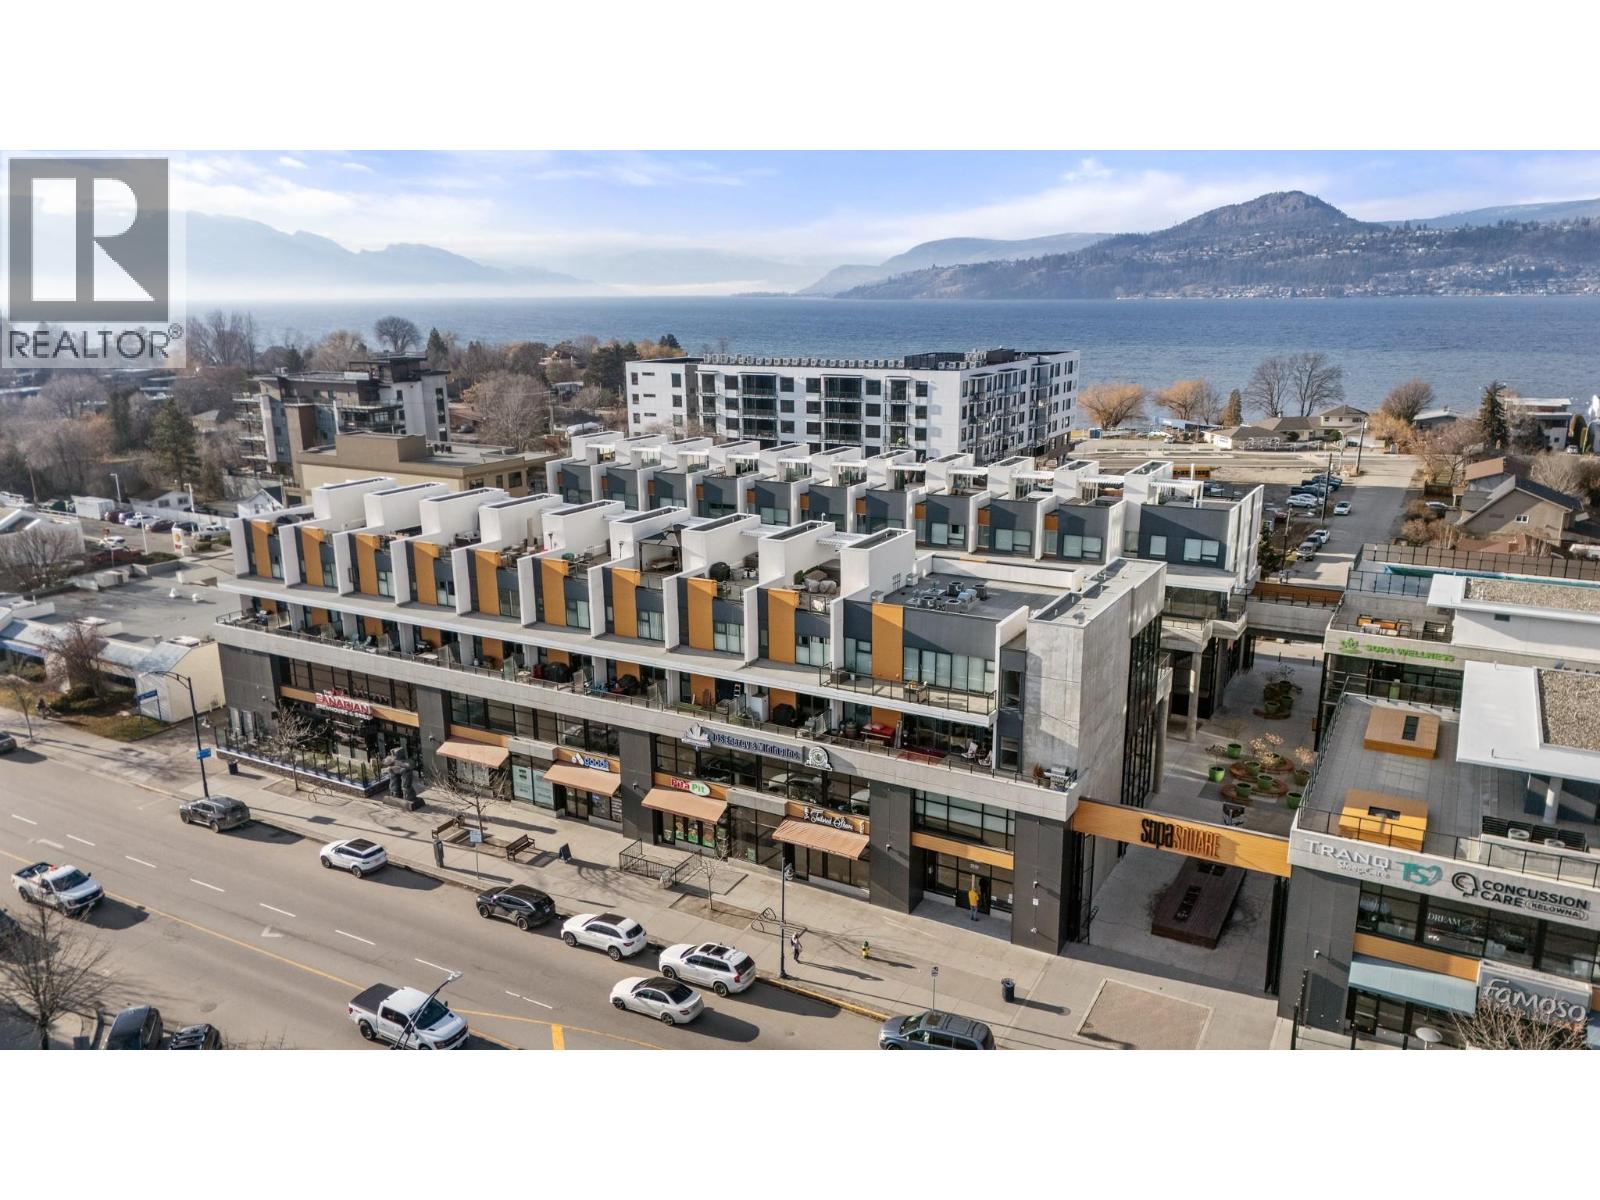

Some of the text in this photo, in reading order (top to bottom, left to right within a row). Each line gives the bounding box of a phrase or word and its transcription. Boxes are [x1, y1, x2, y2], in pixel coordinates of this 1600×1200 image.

[672, 778, 705, 793] Pita Pit
[1174, 825, 1220, 857] SQUARE
[1304, 840, 1391, 871] TRANQ
[1481, 891, 1580, 918] CARE KELOWNA
[1482, 880, 1588, 910] CONCUSSION
[1427, 912, 1461, 927] DREAM
